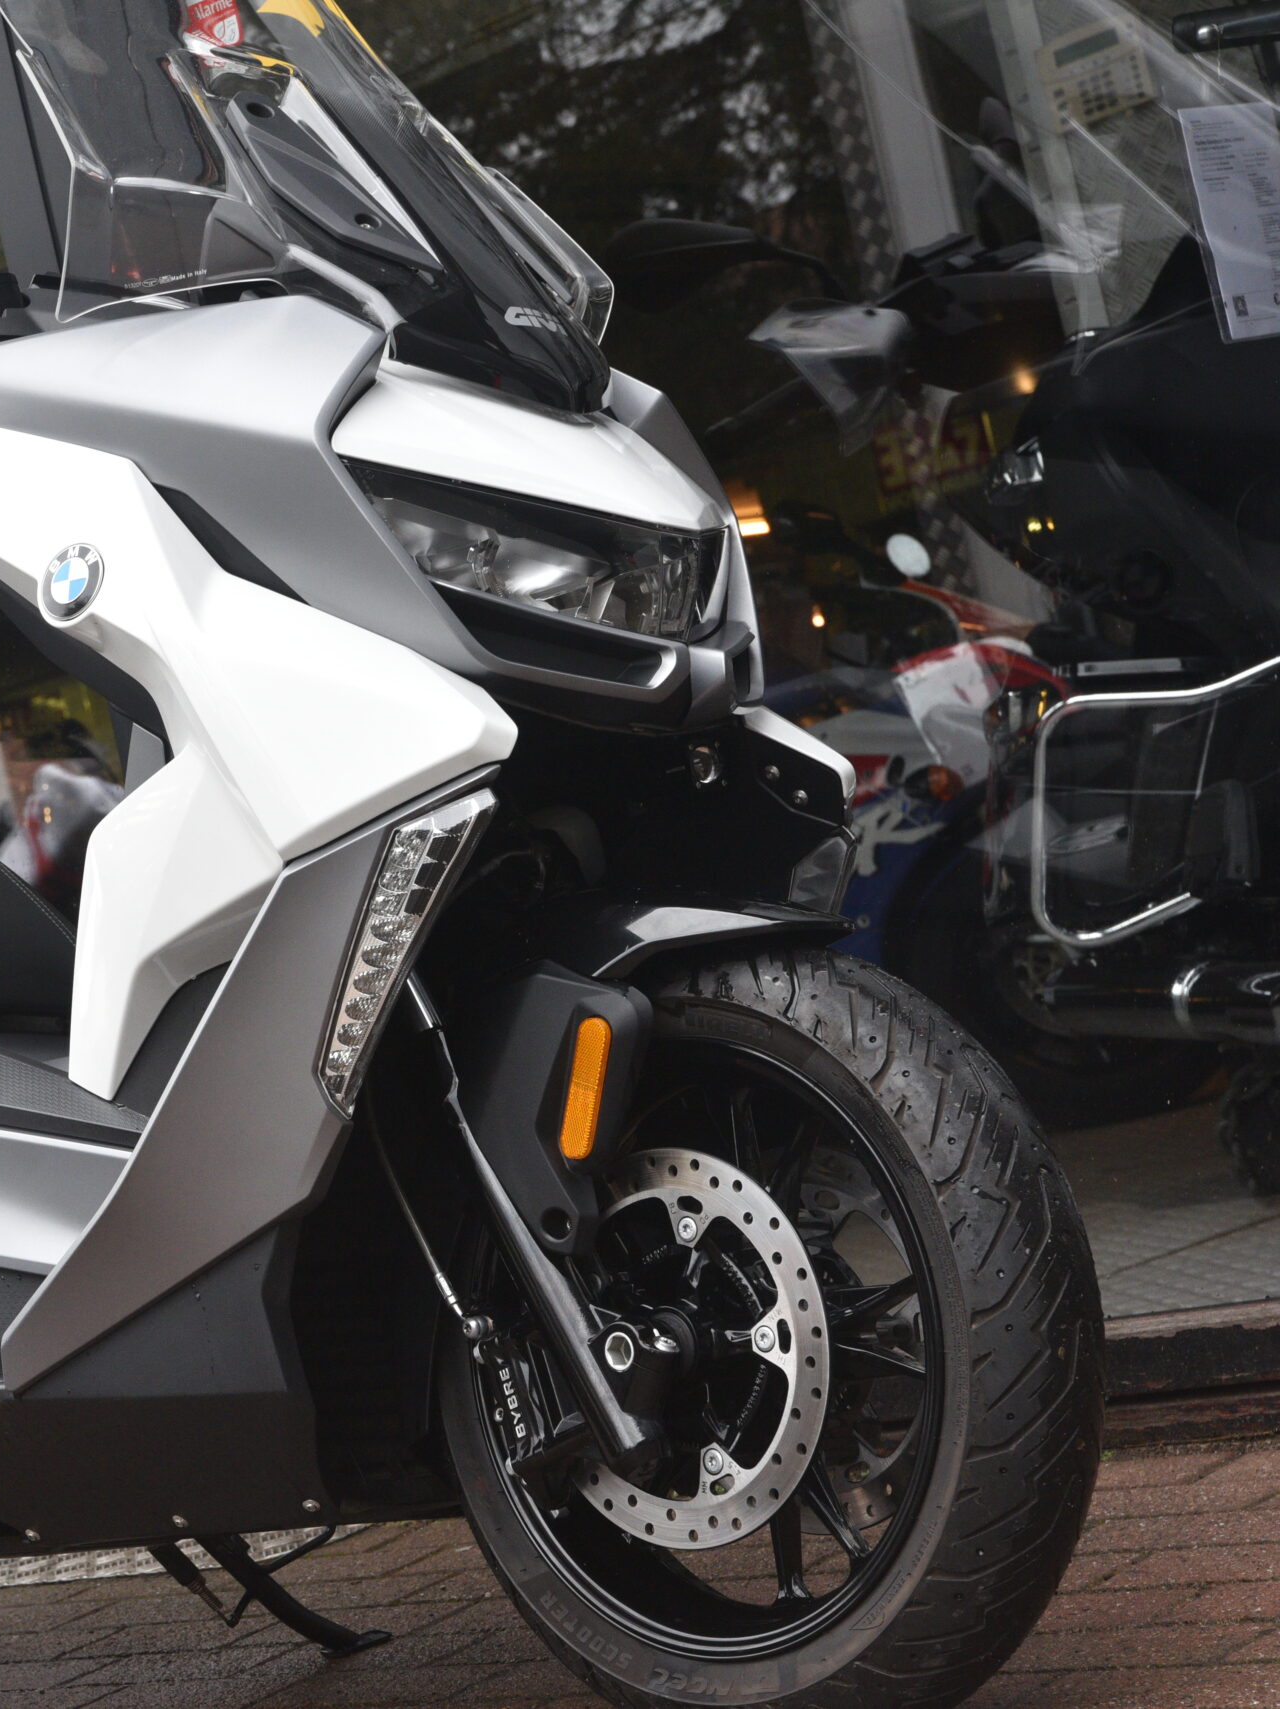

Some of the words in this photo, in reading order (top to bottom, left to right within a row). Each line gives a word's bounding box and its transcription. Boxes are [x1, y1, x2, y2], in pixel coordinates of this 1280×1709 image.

[48, 545, 99, 574] BMW
[499, 1367, 526, 1438] BYBRE
[539, 1591, 634, 1670] SCOOTER
